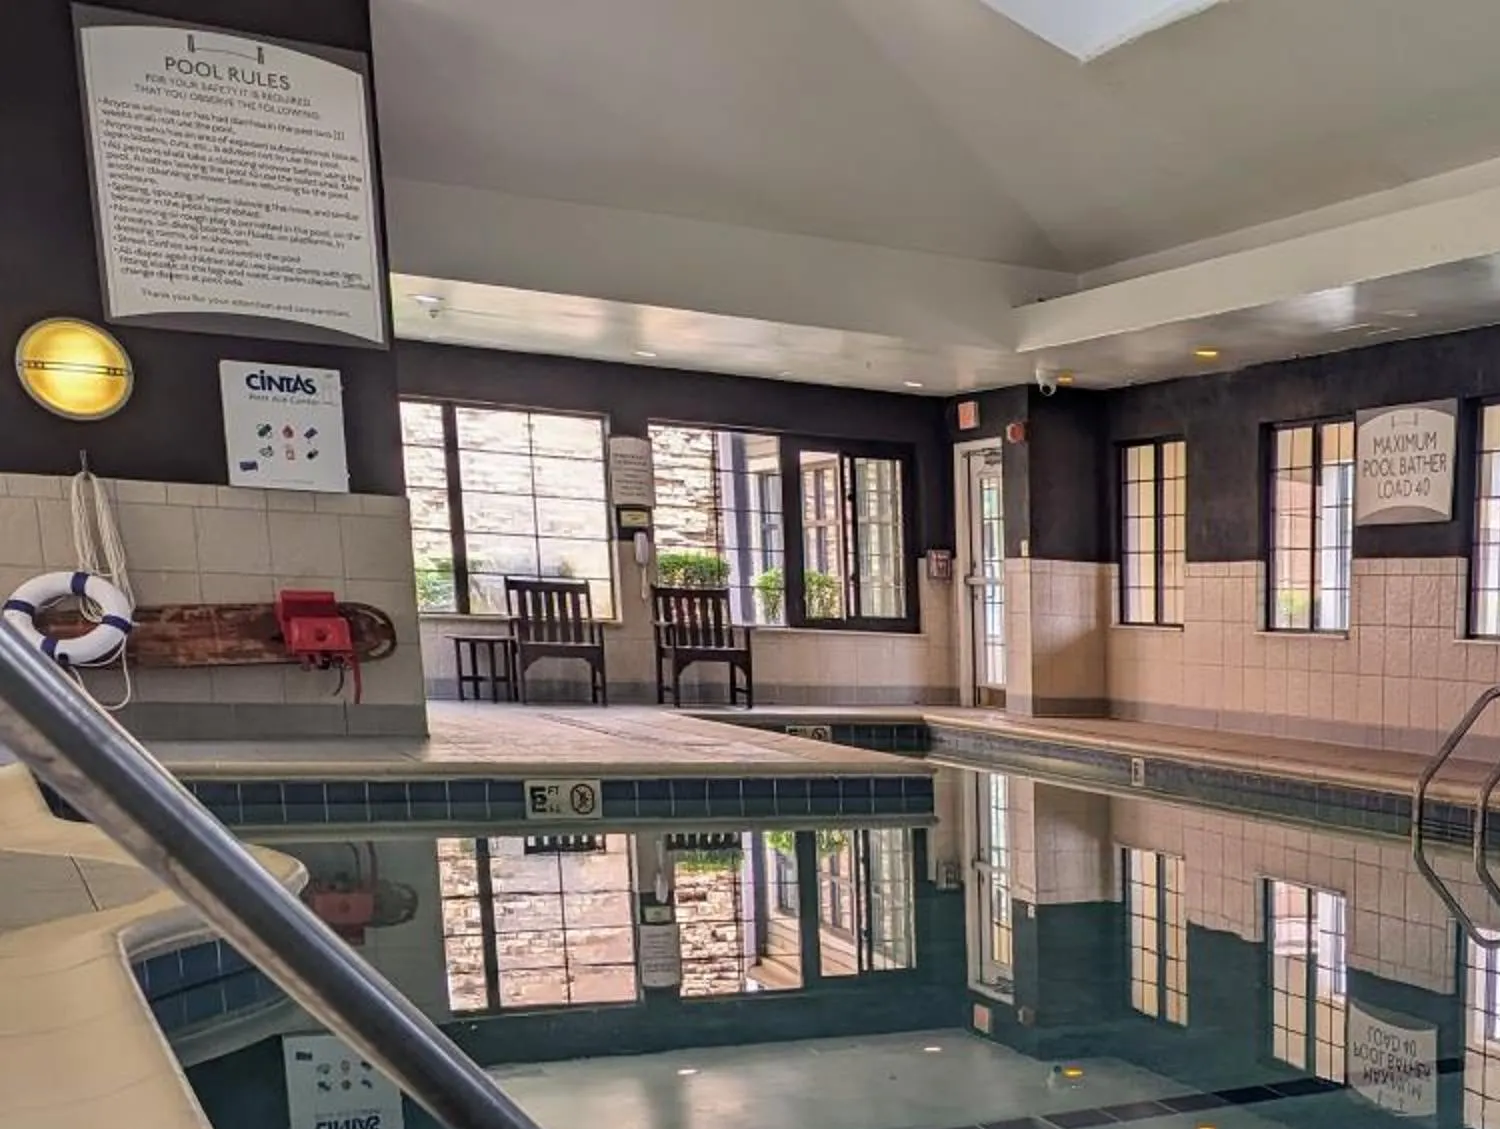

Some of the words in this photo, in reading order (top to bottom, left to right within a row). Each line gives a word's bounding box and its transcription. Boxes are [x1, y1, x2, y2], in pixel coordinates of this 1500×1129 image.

[164, 56, 223, 81] POOL
[228, 66, 291, 91] RULES
[1373, 431, 1437, 456] MAXIMUM
[1363, 458, 1397, 477] POOL
[1399, 453, 1447, 476] BATHER
[1377, 479, 1412, 498] LOAD
[1415, 477, 1431, 496] 40
